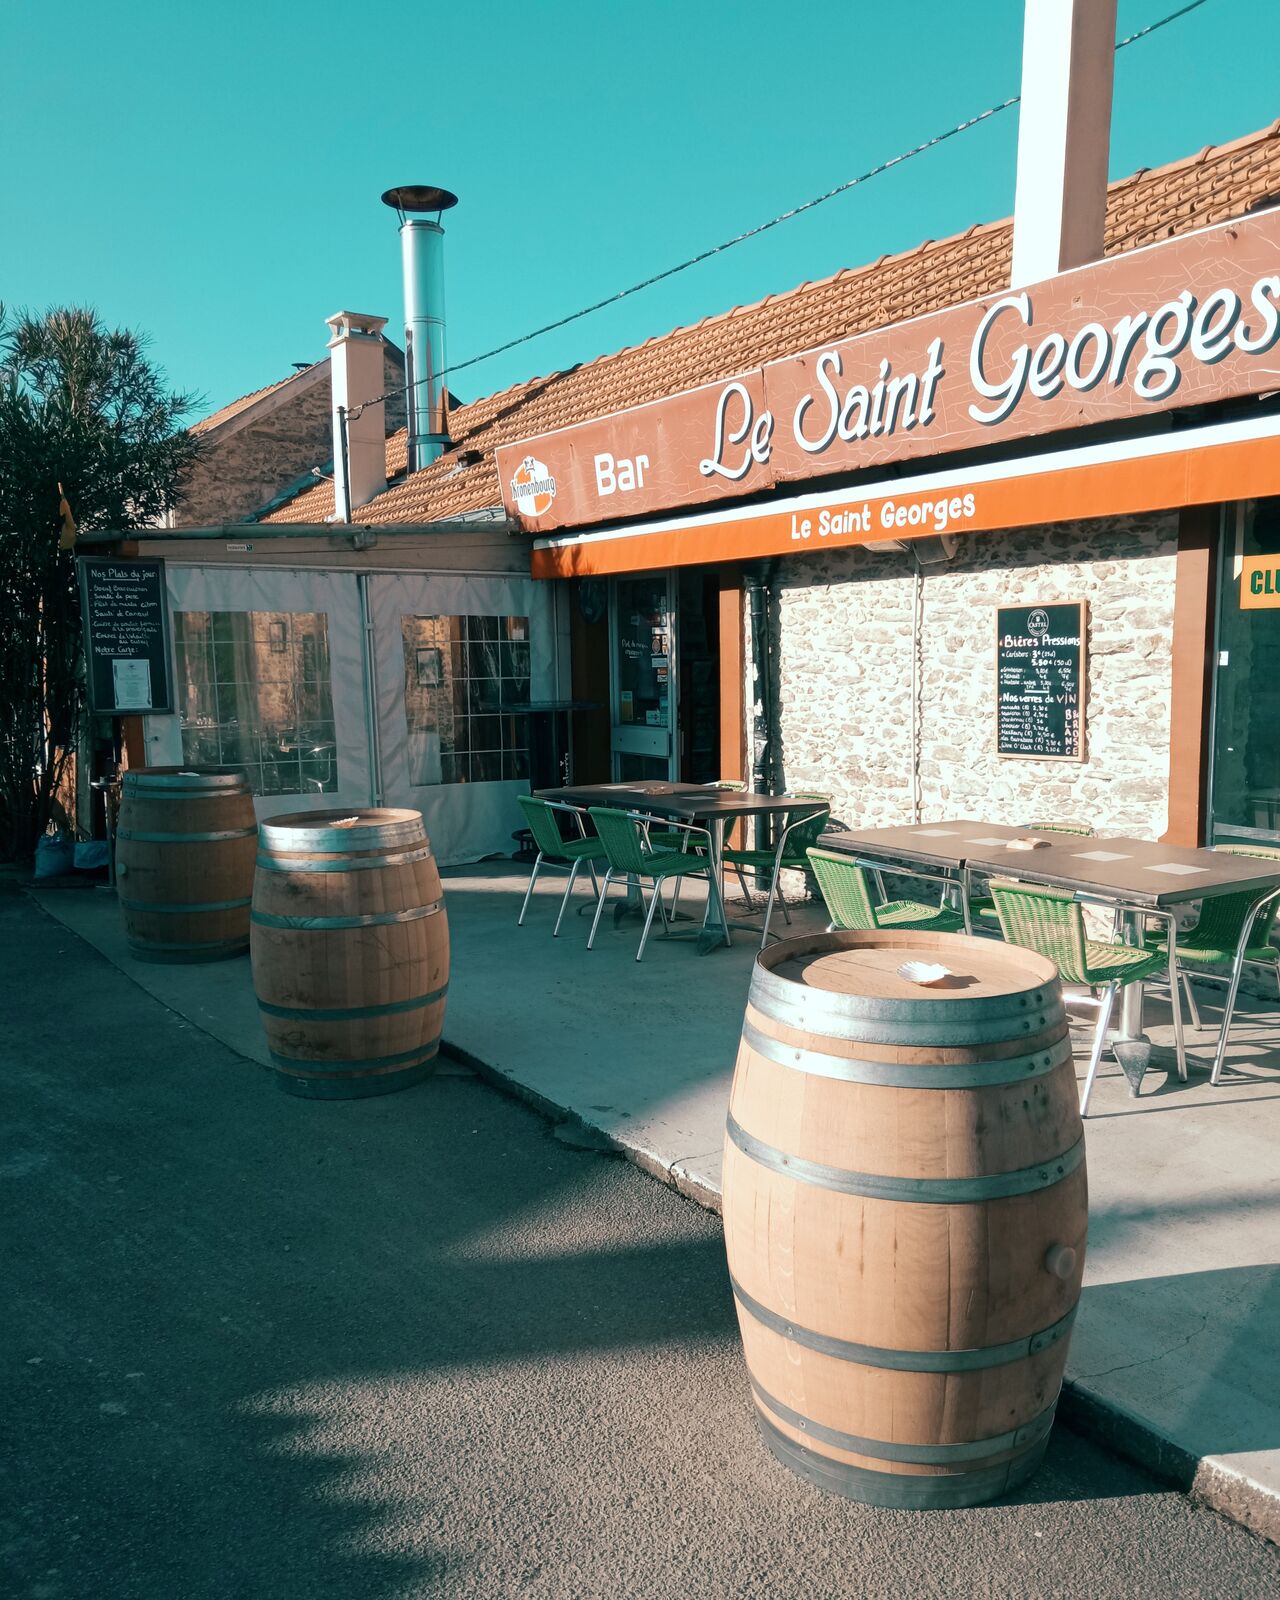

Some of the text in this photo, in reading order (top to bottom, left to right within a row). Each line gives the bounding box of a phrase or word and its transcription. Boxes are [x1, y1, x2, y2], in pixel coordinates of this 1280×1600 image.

[699, 275, 1280, 481] Le Saint Georges
[511, 475, 556, 500] Kronenbourg
[594, 452, 649, 497] Bar
[791, 493, 976, 540] Le Saint Georges
